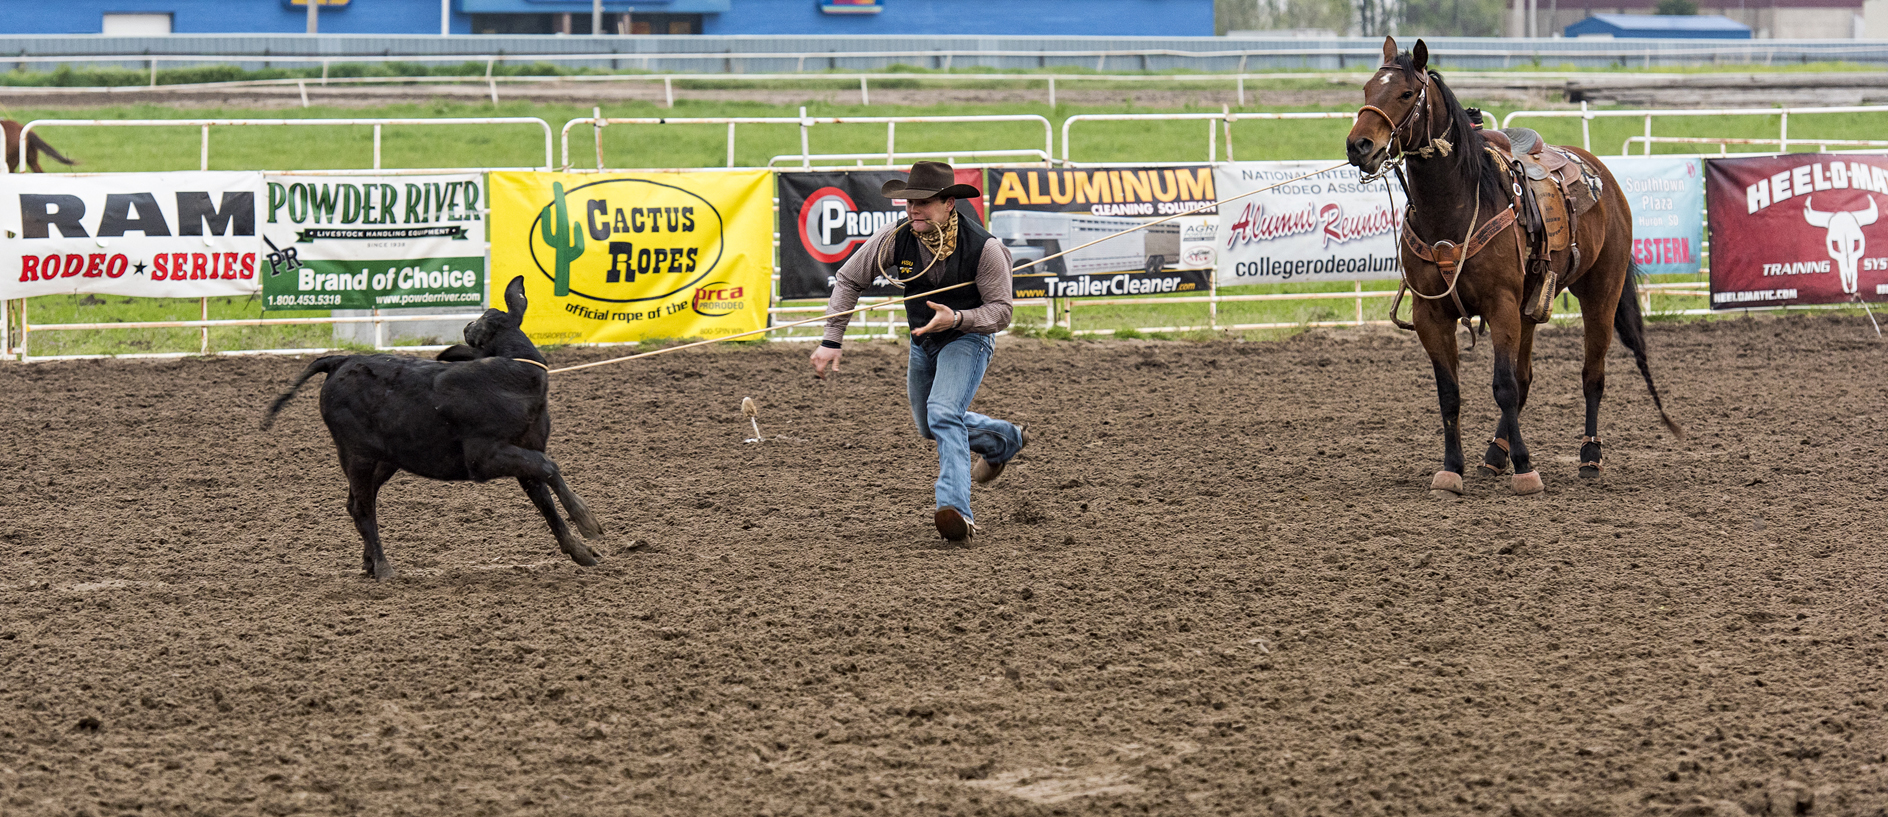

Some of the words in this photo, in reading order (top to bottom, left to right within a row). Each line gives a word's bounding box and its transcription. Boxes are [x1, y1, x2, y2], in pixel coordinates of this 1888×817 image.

[1242, 169, 1313, 181] NATIONAL
[993, 167, 1216, 206] ALUMINUM
[1271, 183, 1322, 195] RODEO
[1626, 177, 1685, 193] Southtown
[266, 182, 398, 225] POWDER
[403, 180, 481, 225] RIVER
[1090, 203, 1155, 217] CLEANING
[1157, 201, 1217, 215] SOLUTION
[1641, 195, 1673, 210] Plaza
[19, 191, 256, 239] RAM
[1638, 215, 1663, 227] Huron
[1668, 214, 1679, 227] SD
[1186, 224, 1219, 233] AGRI
[1227, 201, 1315, 248] Alumni
[1319, 202, 1404, 248] Reunion
[316, 230, 364, 238] LIVESTOCK
[365, 229, 407, 237] HANDLING
[408, 228, 450, 236] EQUIPMENT
[1632, 237, 1690, 265] ESTERN
[19, 253, 129, 282] RODEO
[151, 252, 256, 281] SERIES
[1762, 260, 1831, 277] TRAINING
[1863, 257, 1888, 271] SYS
[298, 267, 369, 291] Brand
[371, 267, 398, 290] of
[397, 265, 477, 290] Choice
[1015, 273, 1196, 298] www.TrailerCleaner.com
[267, 294, 342, 306] 1.800.453.5318
[376, 291, 481, 305] www.powderriver.com
[693, 286, 744, 311] prca
[1713, 289, 1798, 304] HEELOMATIC.COM
[564, 301, 609, 322] official
[611, 310, 643, 323] rope
[647, 305, 663, 320] of
[666, 300, 689, 312] the
[698, 301, 744, 310] PRORODEO
